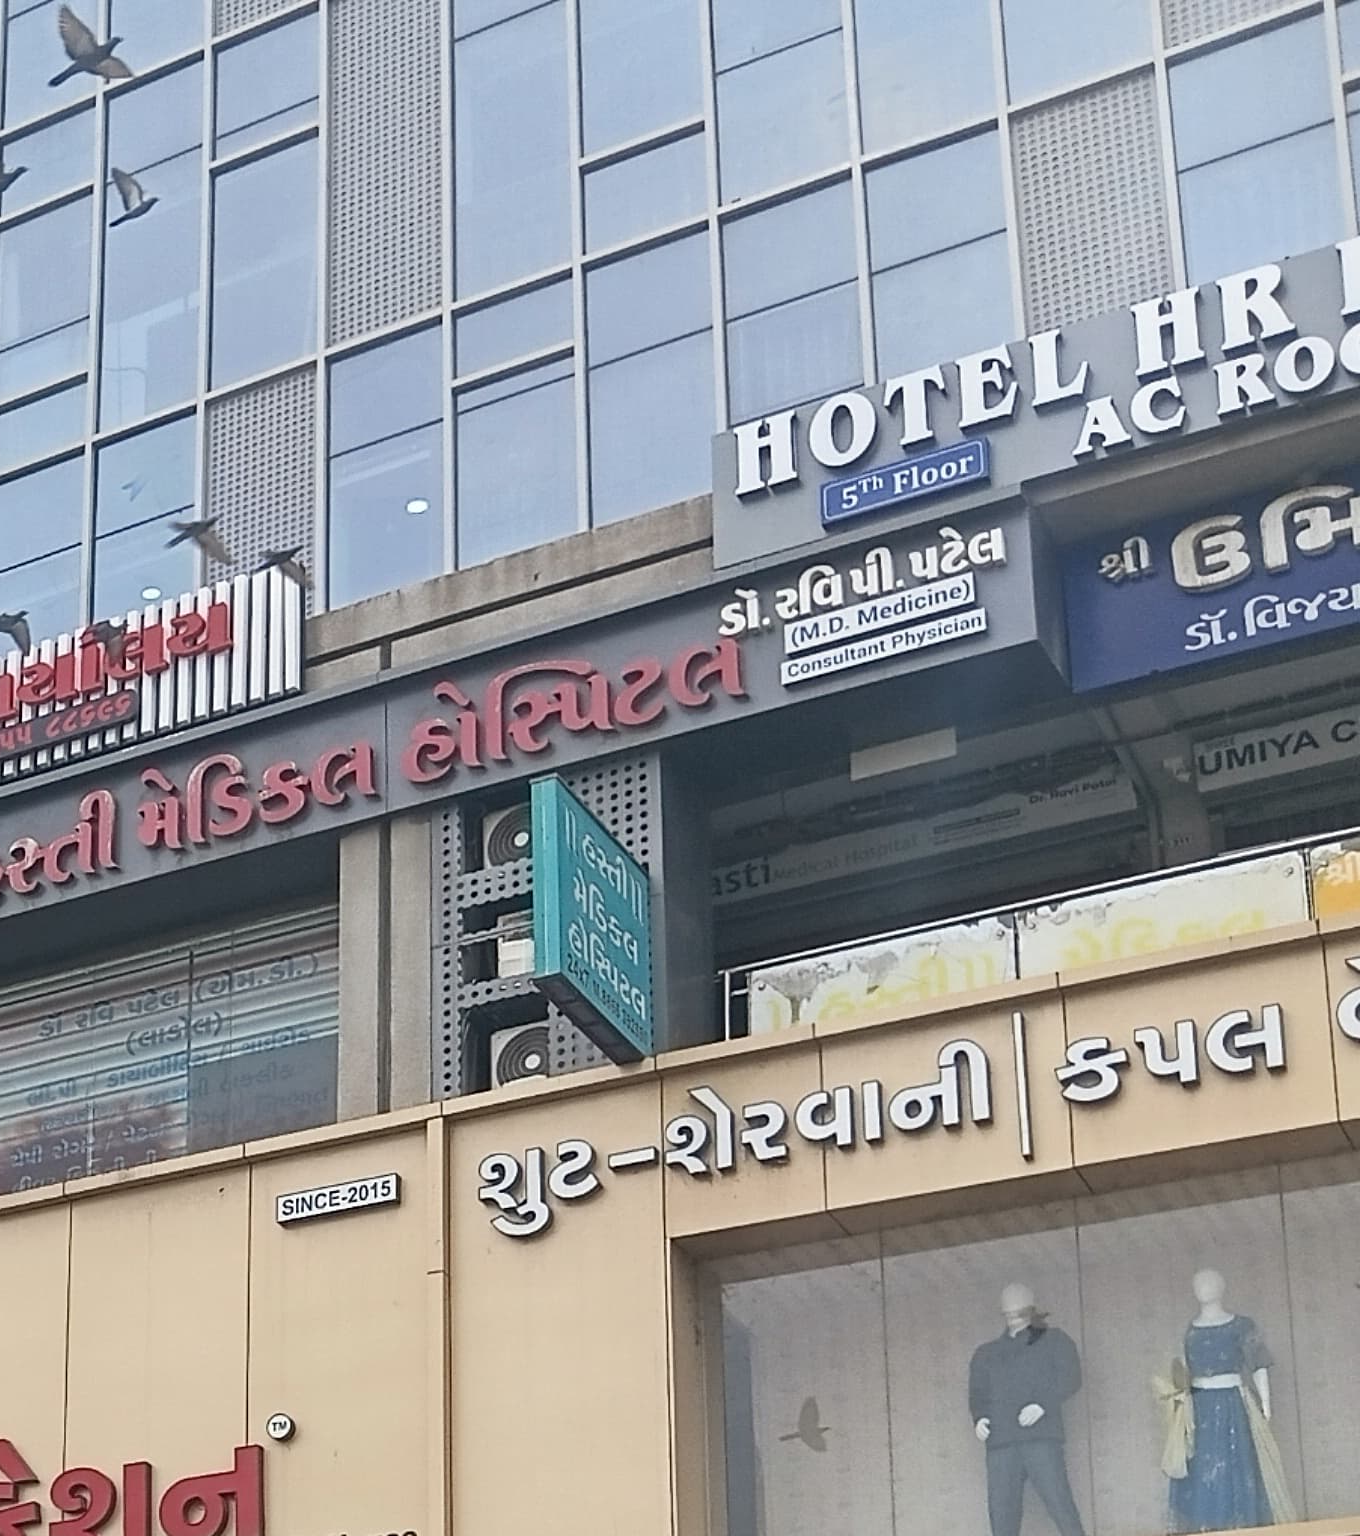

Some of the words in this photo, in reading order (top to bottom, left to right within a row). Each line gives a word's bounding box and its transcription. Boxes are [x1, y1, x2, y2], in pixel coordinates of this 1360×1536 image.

[734, 329, 1089, 498] HOTEL
[1130, 261, 1296, 378] HR
[1072, 379, 1186, 458] AC
[786, 639, 887, 681] Consultant
[890, 611, 984, 656] Physician
[789, 619, 851, 650] (M.D.
[856, 578, 972, 629] Medicine)
[134, 751, 376, 851] મેડિકલ
[401, 635, 748, 785] હોસ્પિટલ
[1198, 724, 1320, 778] UMIYA
[476, 1033, 995, 1239] શુટ-શેરવાની
[1055, 1000, 1288, 1104] કપલ
[280, 1179, 393, 1218] SINCE-2015
